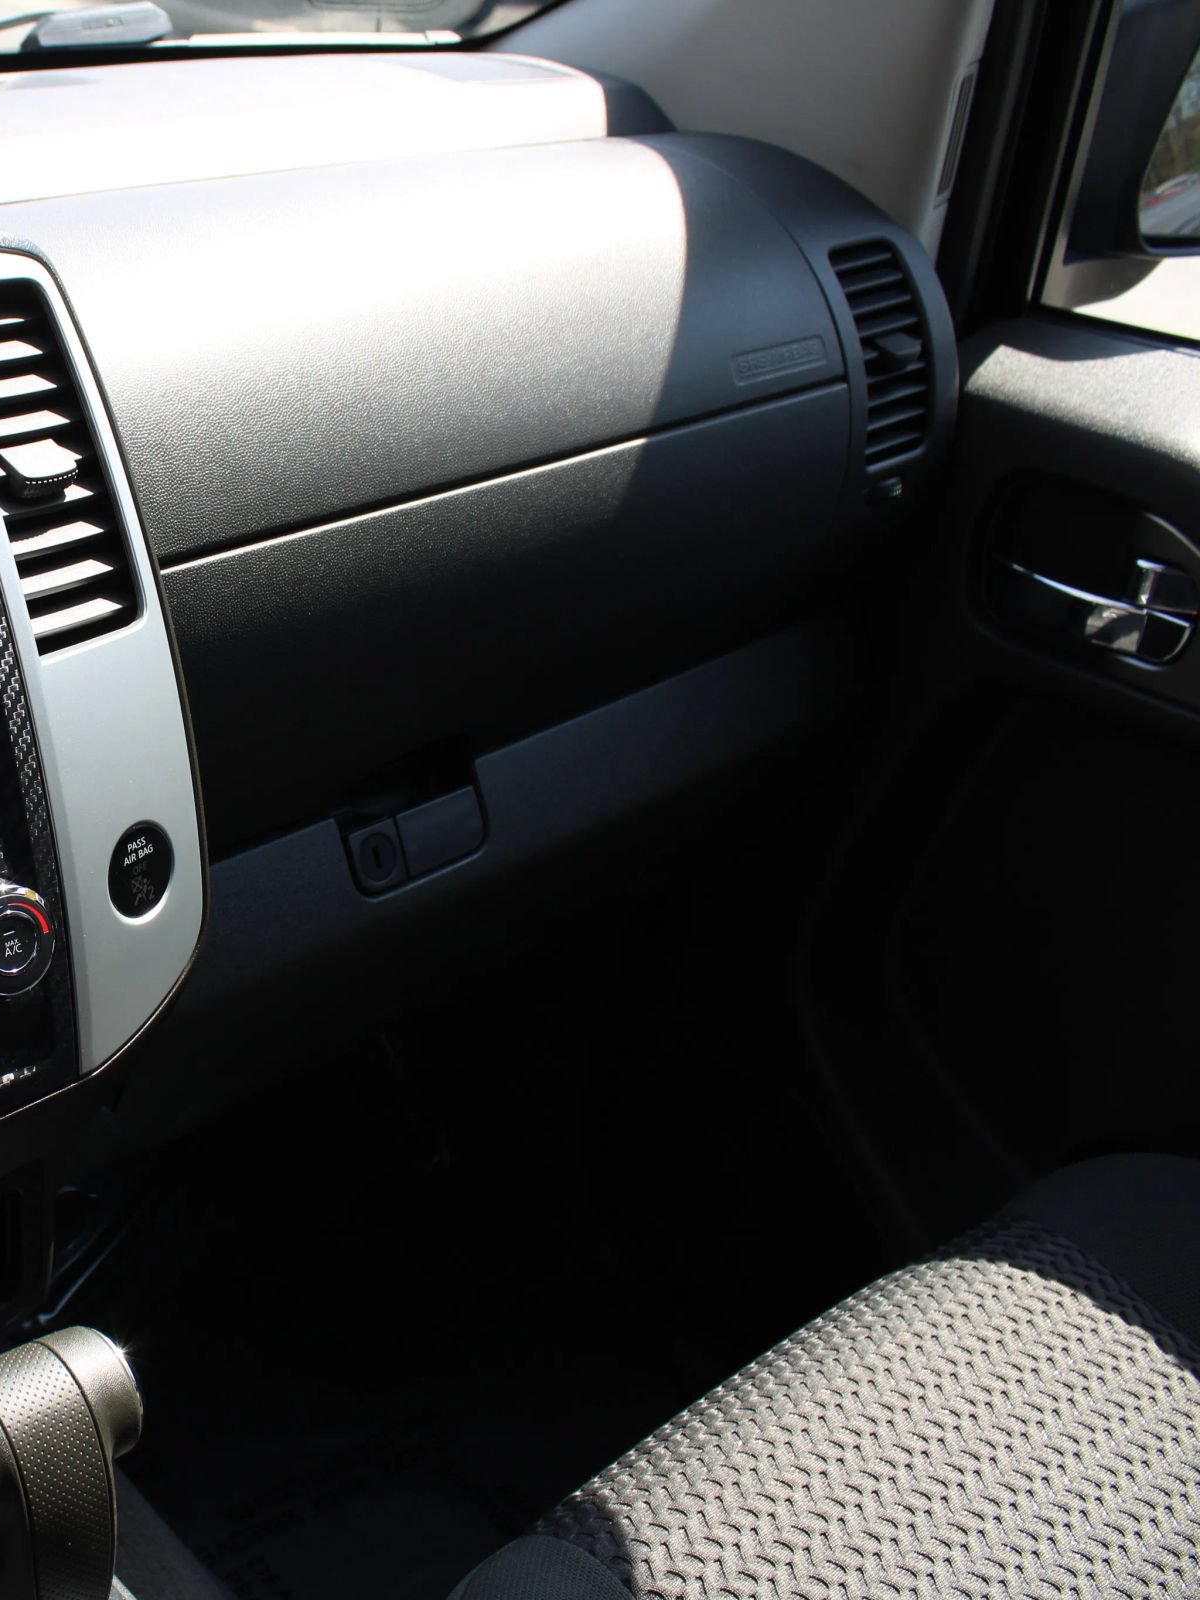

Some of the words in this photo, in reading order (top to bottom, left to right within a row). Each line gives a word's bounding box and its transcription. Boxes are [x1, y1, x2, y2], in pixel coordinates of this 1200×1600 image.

[127, 837, 146, 852] PASS
[123, 853, 137, 867] AIR
[138, 844, 154, 859] BAG
[4, 938, 19, 947] MAX
[5, 943, 23, 958] A/C
